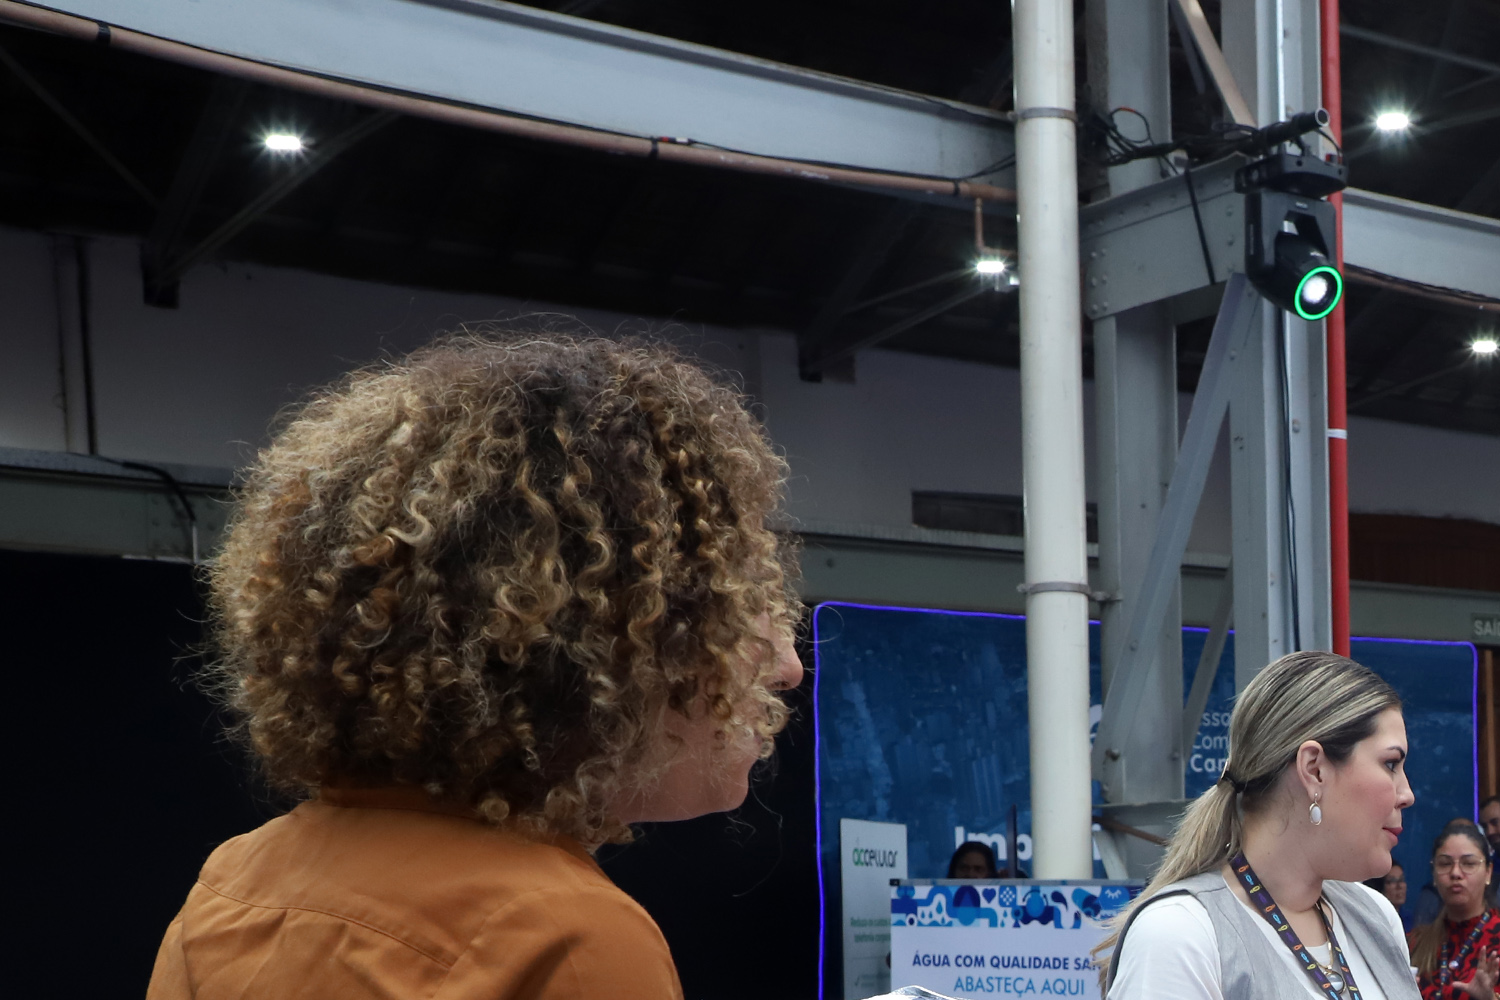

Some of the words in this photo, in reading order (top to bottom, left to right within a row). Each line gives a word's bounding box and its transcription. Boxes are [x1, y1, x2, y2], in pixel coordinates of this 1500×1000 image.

[912, 951, 950, 967] ÁGUA
[955, 954, 985, 968] COM
[990, 955, 1069, 970] QUALIDADE
[954, 976, 1036, 997] ABASTEÇA
[1041, 979, 1085, 996] AQUI
